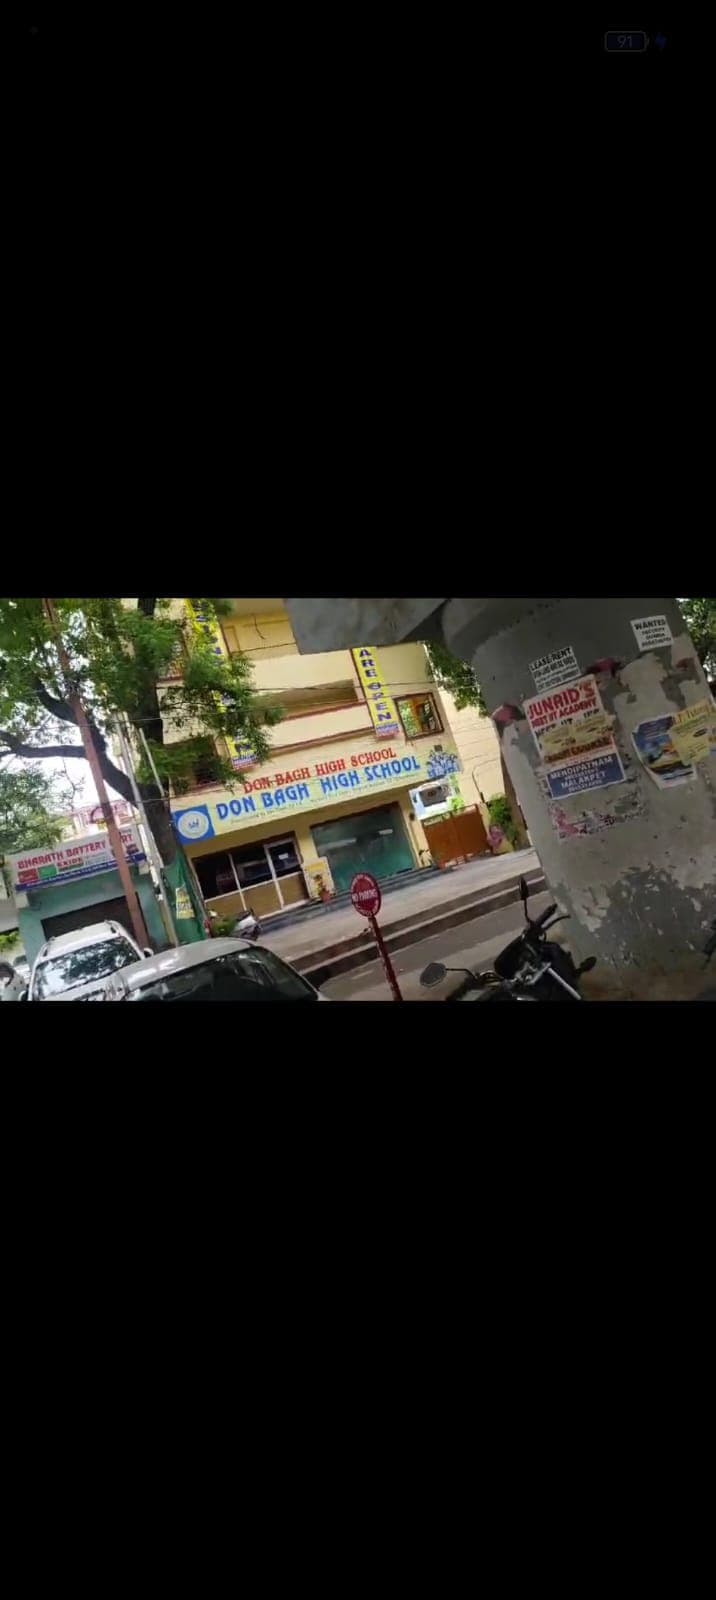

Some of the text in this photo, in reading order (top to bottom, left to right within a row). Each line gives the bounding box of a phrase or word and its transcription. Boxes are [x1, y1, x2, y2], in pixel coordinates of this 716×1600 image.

[634, 619, 667, 630] WANTED
[359, 649, 377, 677] ARE
[368, 682, 392, 721] OPEN
[527, 682, 596, 719] JUNAID'S
[559, 697, 597, 721] ACADEMY
[243, 747, 397, 794] DON BAGH HIGH SCHOOL
[215, 796, 257, 820] DON
[262, 782, 311, 809] BAGH
[319, 769, 361, 794] HIGH
[366, 755, 421, 782] SCHOOL
[17, 852, 65, 869] BHARATH
[66, 841, 107, 857] BATTERY
[57, 857, 84, 868] EXIDE
[351, 888, 379, 902] NO PARKING
